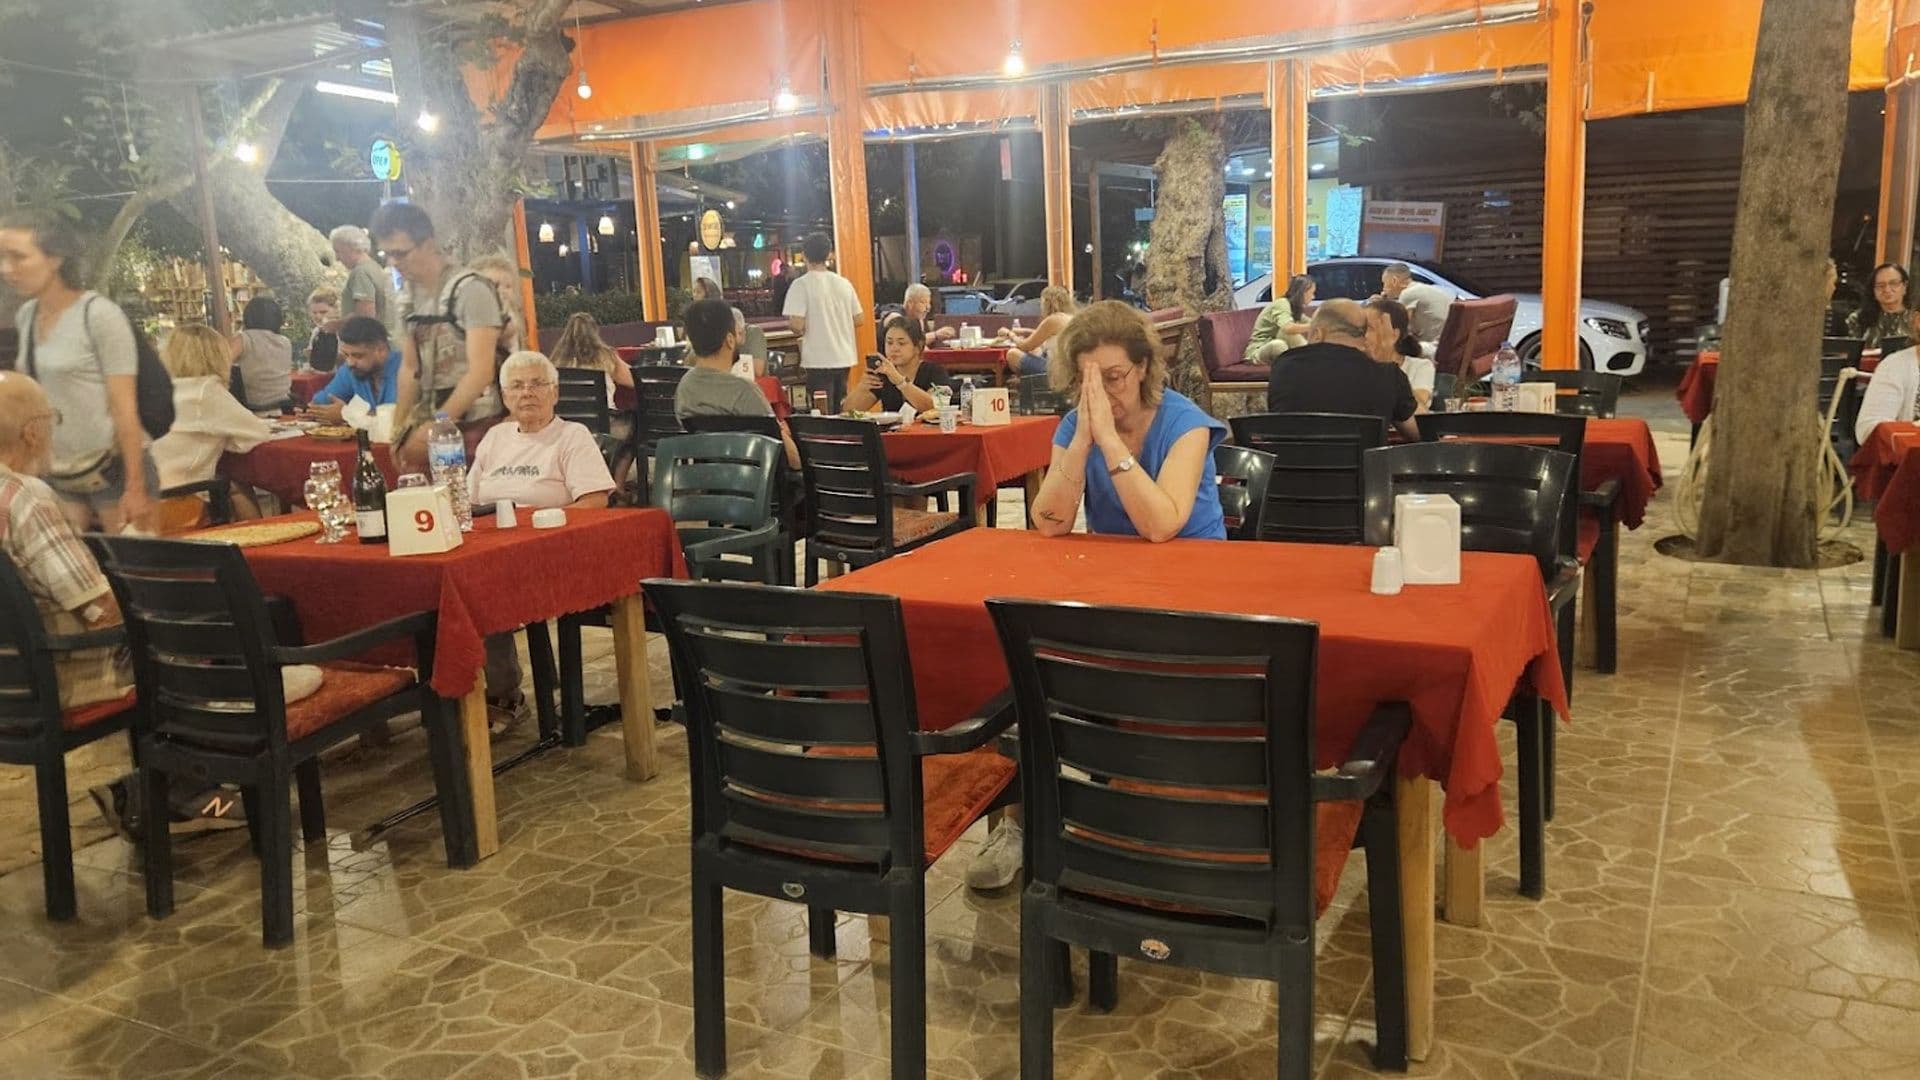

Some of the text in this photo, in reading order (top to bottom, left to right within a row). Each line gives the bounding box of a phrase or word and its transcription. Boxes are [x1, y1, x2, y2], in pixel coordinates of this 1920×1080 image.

[742, 362, 749, 373] 5
[991, 398, 1005, 412] 10
[1543, 394, 1553, 412] 11
[414, 509, 435, 533] 9
